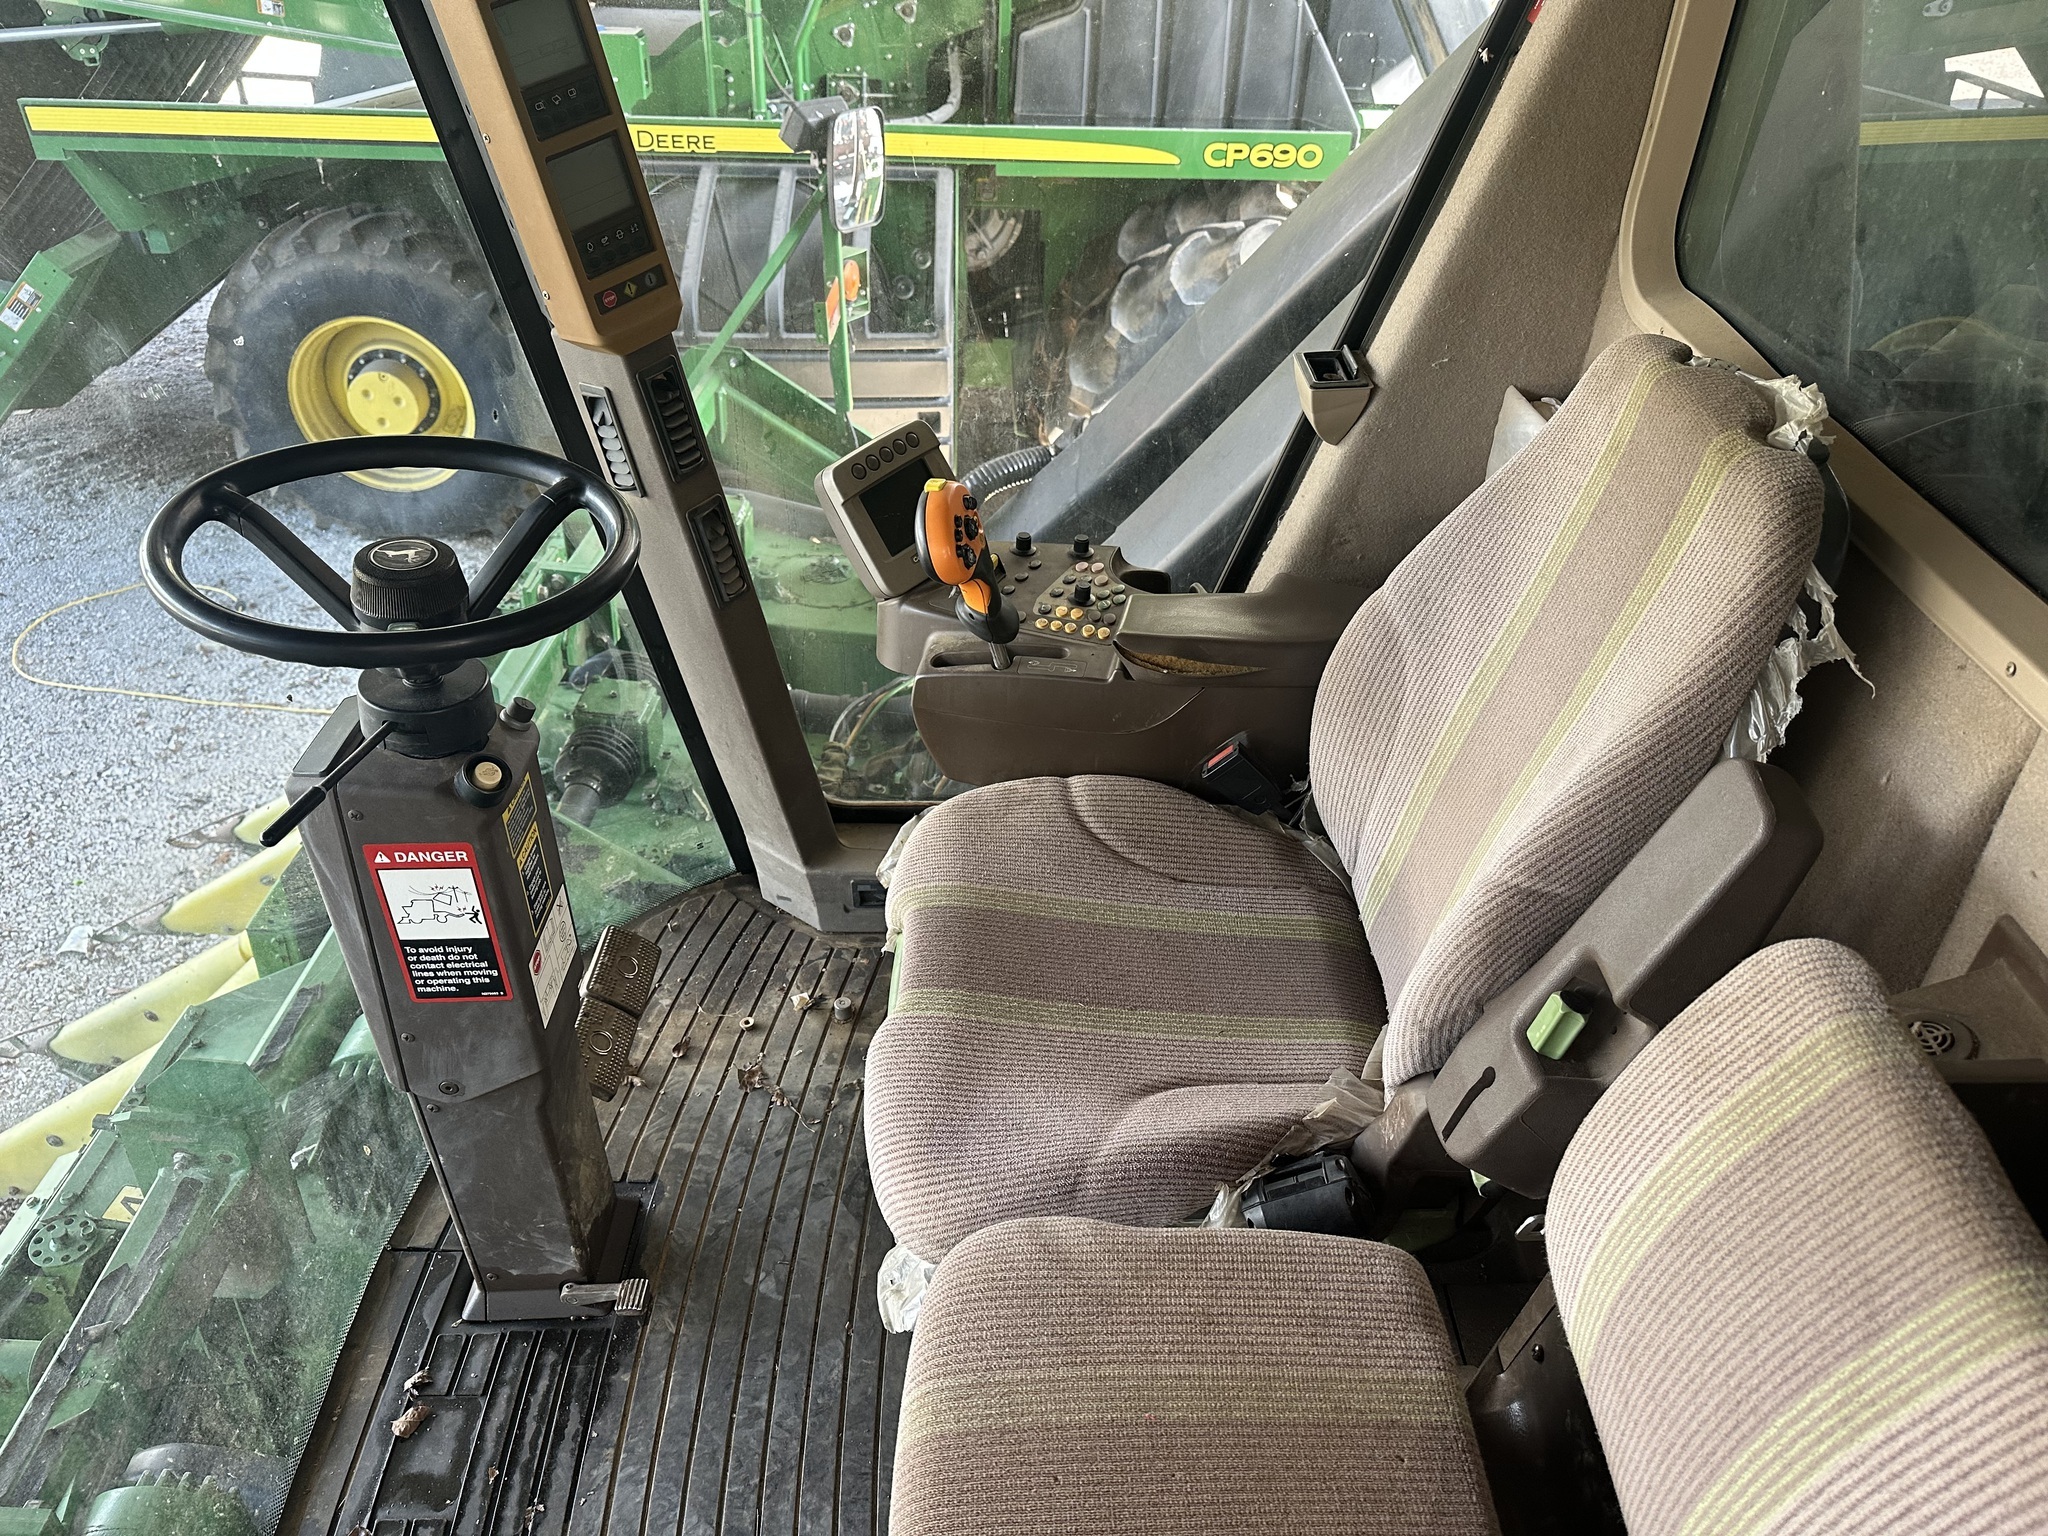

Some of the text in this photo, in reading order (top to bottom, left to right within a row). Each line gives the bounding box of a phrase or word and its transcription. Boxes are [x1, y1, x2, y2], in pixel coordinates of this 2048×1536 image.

[636, 130, 716, 150] DEERE
[1203, 141, 1324, 169] CP690
[393, 850, 469, 863] DANGER
[404, 945, 472, 954] To avoid injury
[419, 954, 446, 962] death
[461, 953, 478, 961] not
[446, 961, 489, 969] electrical
[435, 969, 462, 977] when
[463, 969, 499, 977] moving
[426, 977, 472, 986] operating
[417, 985, 460, 993] machine.
